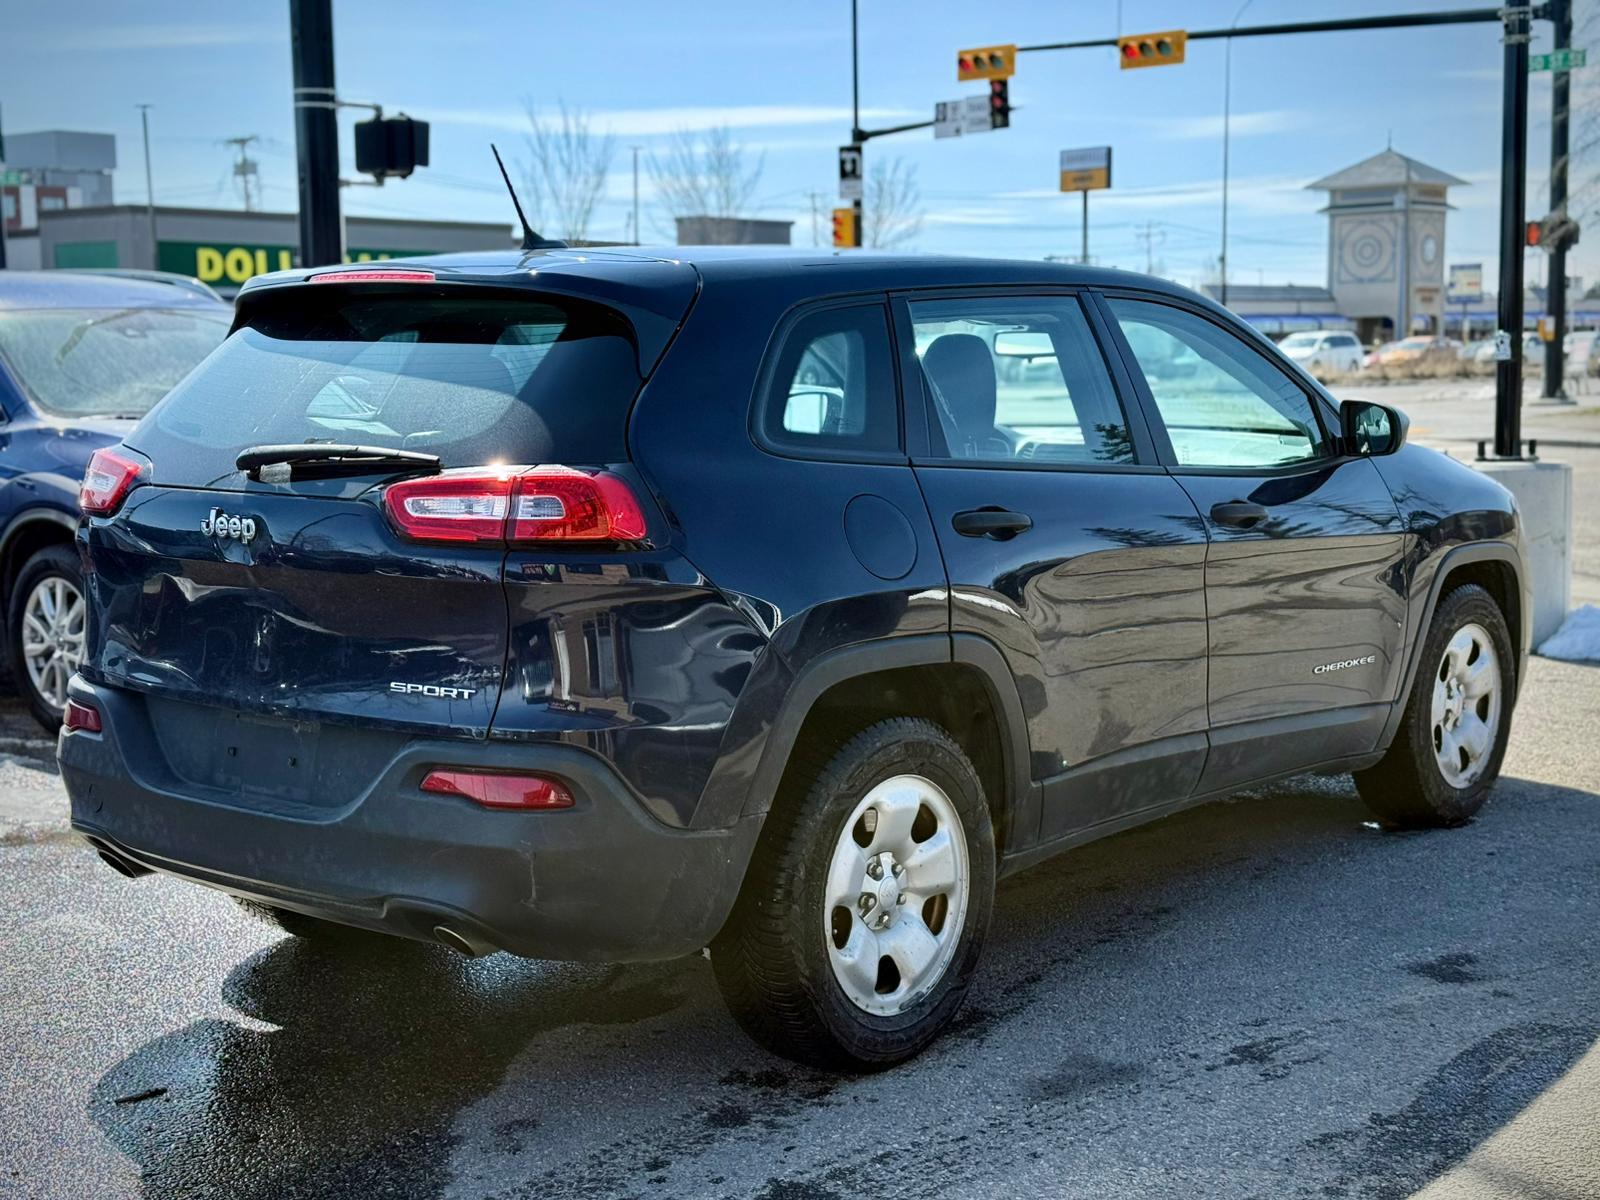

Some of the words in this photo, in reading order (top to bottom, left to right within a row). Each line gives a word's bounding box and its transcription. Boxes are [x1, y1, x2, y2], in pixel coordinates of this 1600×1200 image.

[200, 506, 256, 544] Jeep
[1313, 655, 1376, 675] CHEROKEE
[389, 681, 476, 700] SPORT
